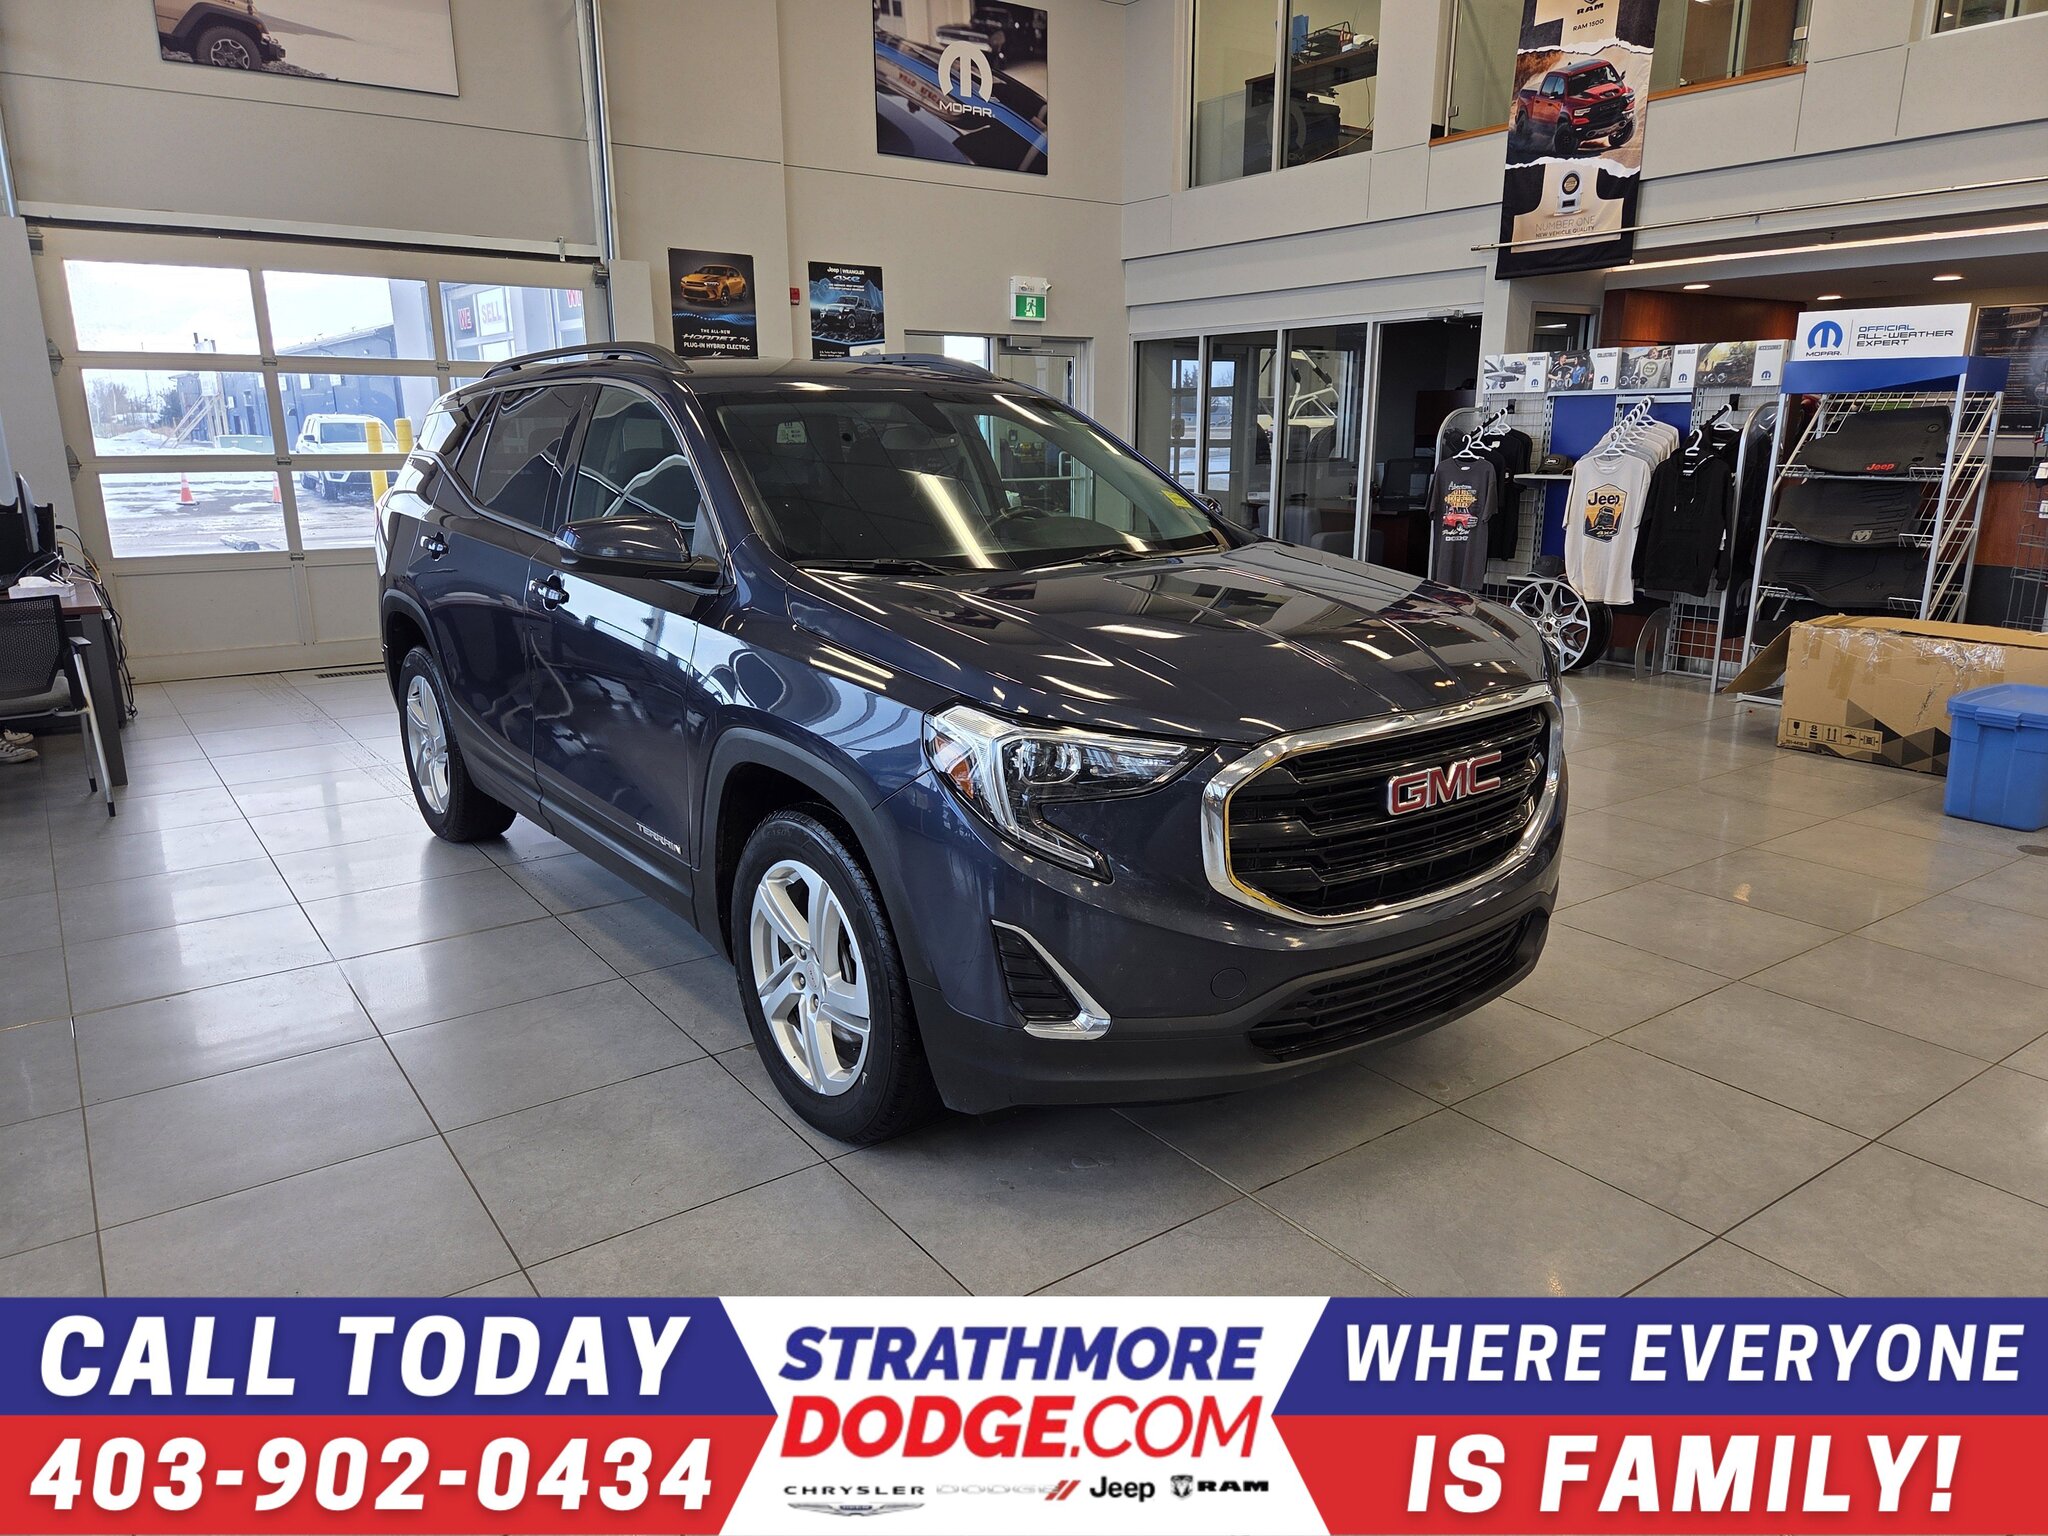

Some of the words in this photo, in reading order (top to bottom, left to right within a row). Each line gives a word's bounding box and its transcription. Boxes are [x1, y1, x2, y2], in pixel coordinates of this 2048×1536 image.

[1576, 2, 1604, 15] RAM
[1572, 23, 1588, 31] RAM
[1589, 18, 1605, 27] 1500
[1535, 218, 1574, 232] NUMBER
[1577, 215, 1596, 227] ONE
[1572, 225, 1595, 234] QUALITY
[457, 306, 473, 330] WE
[481, 301, 504, 324] SELL
[1858, 324, 1915, 333] OFFICIAL
[682, 333, 738, 341] HORNET
[1857, 330, 1954, 340] ALL-WEATHER
[706, 342, 726, 350] HYBRID
[1856, 339, 1909, 347] EXPERT
[1866, 463, 1895, 471] Jeep
[1388, 751, 1502, 816] GMC
[636, 822, 682, 855] TERRAIN
